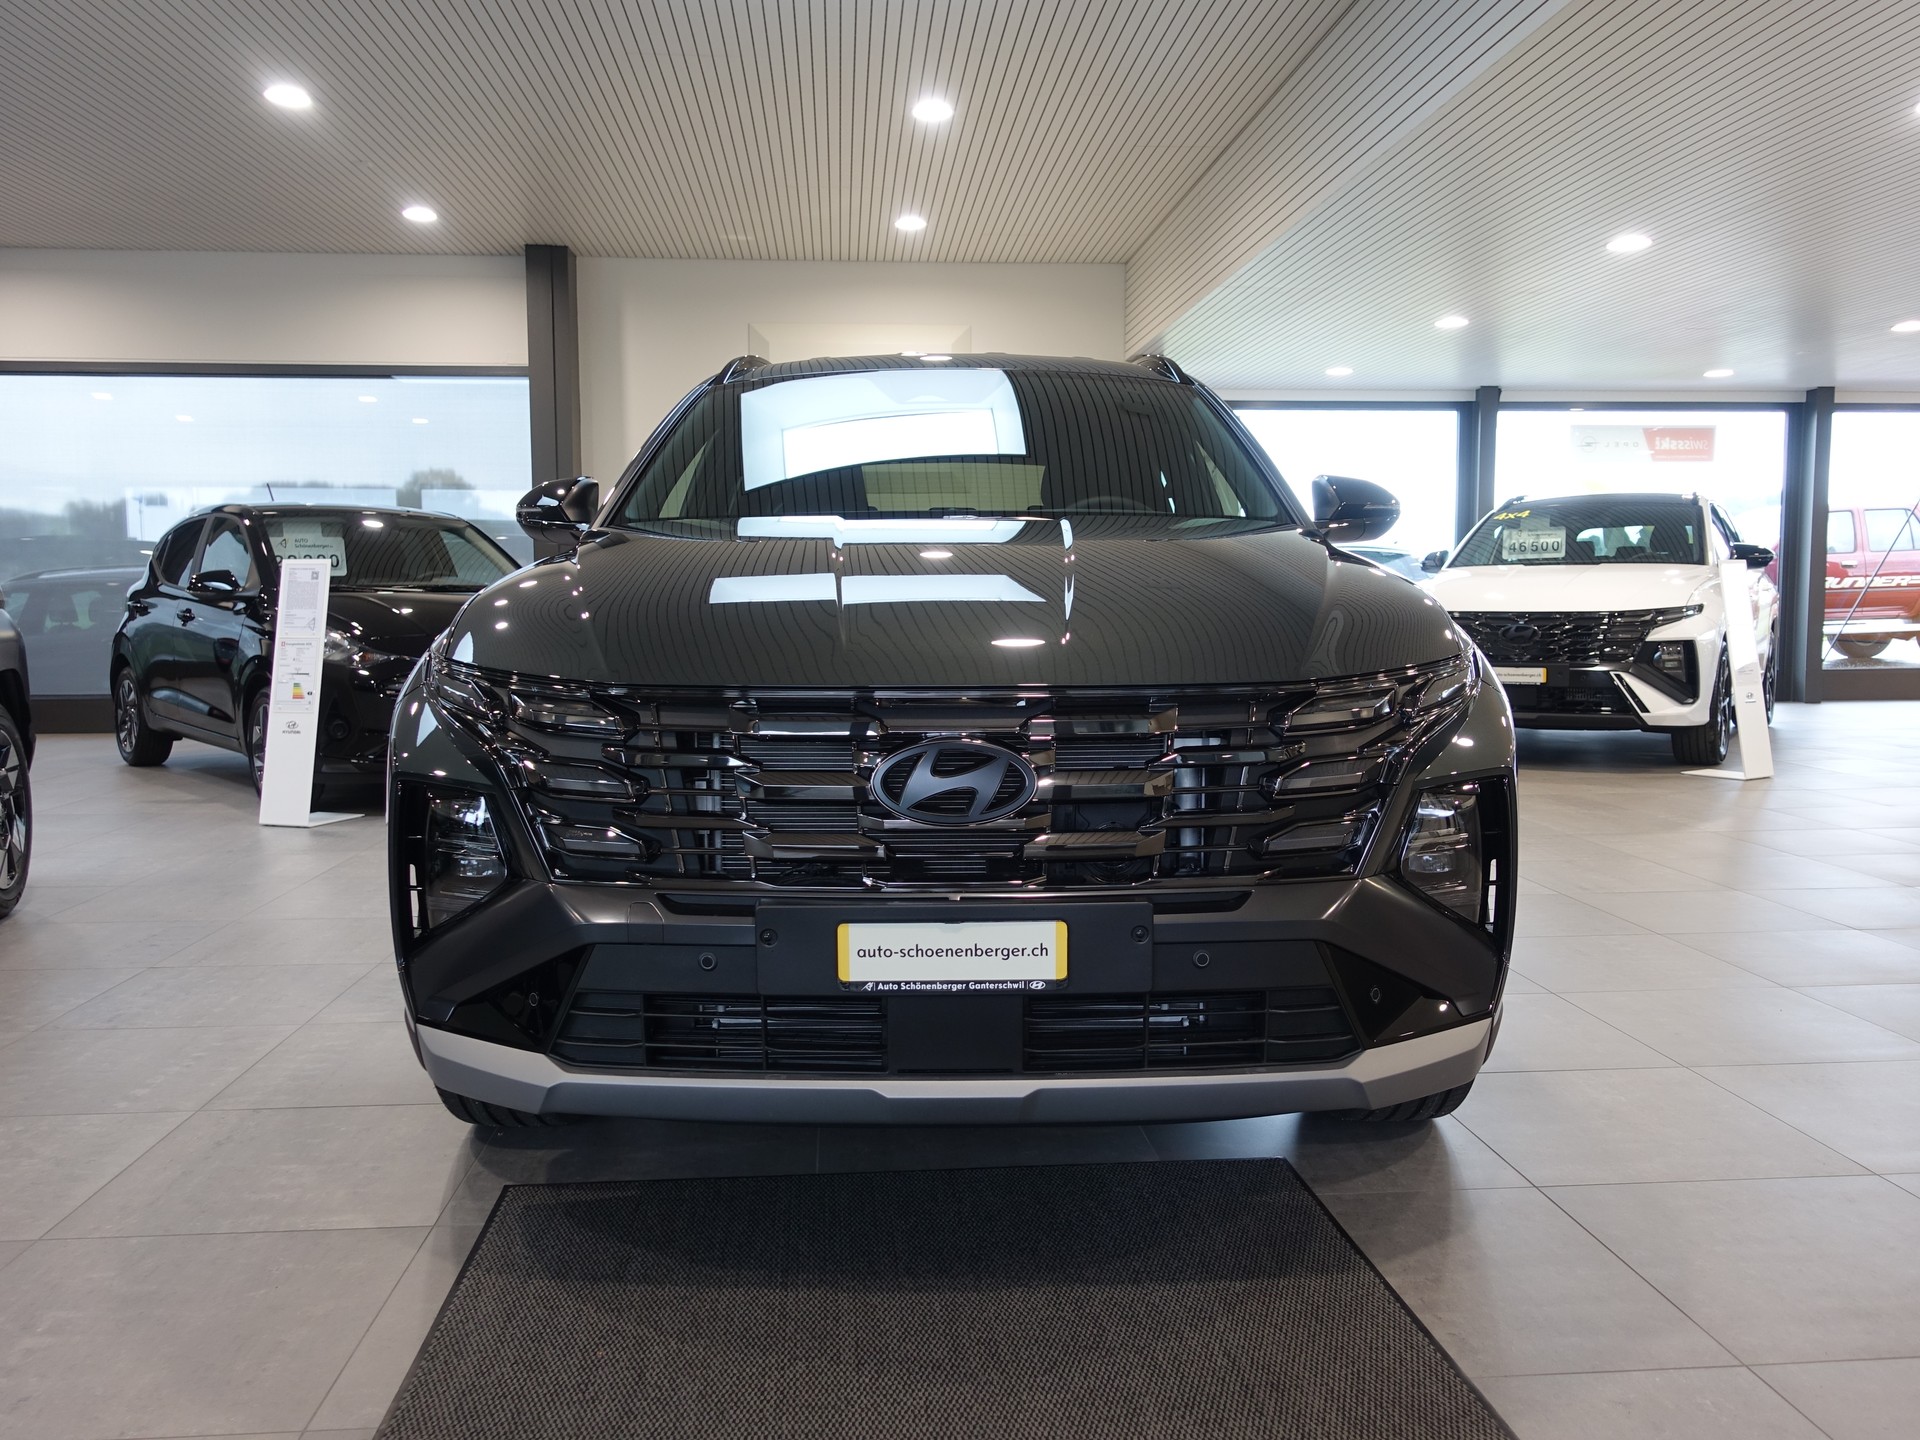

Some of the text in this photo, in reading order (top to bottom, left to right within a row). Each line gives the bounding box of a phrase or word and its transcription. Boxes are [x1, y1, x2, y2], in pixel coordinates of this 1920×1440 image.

[1493, 510, 1531, 520] 4x4
[1509, 541, 1560, 552] 46500
[857, 943, 1048, 960] auto-schoenenberger.ch
[901, 981, 966, 991] Schönenberger
[969, 981, 1025, 989] Ganterschwil
